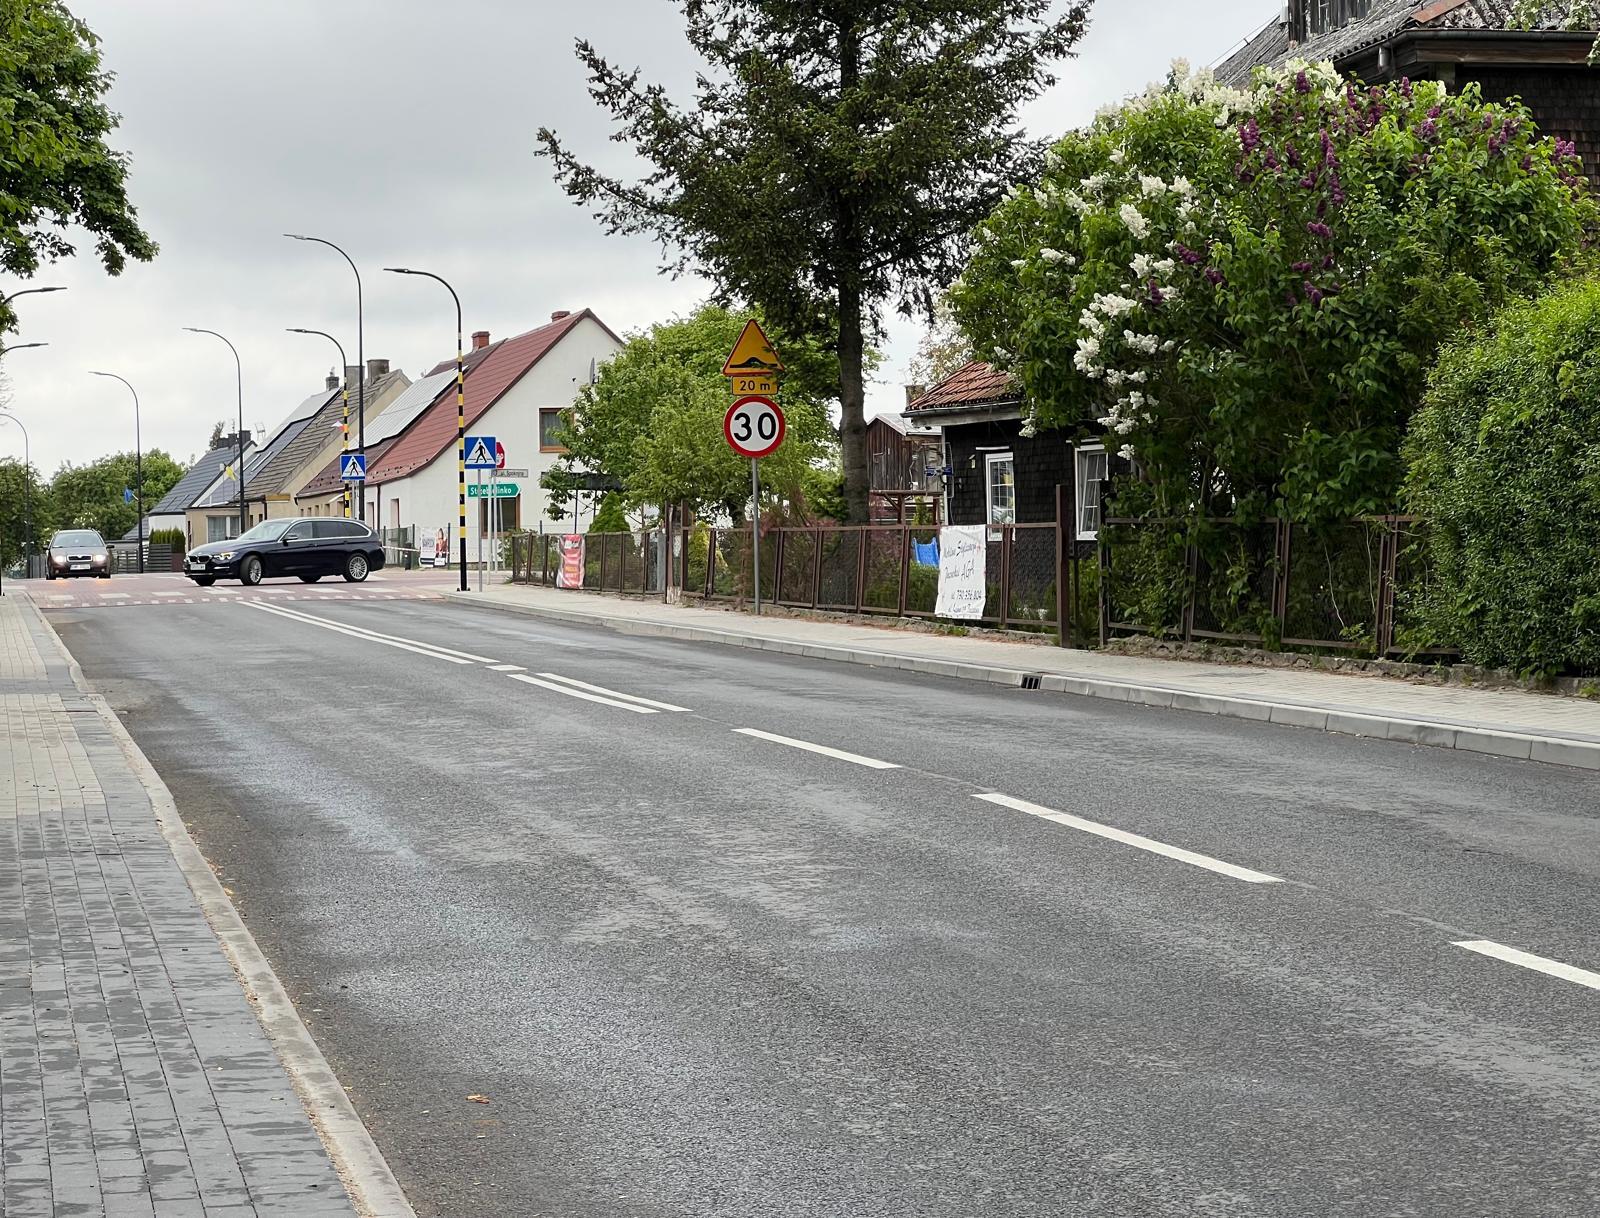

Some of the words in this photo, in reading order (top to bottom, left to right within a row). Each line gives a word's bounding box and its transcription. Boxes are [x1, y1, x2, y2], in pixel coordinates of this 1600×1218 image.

[740, 380, 756, 391] 20
[760, 383, 771, 391] m
[733, 412, 777, 442] 30
